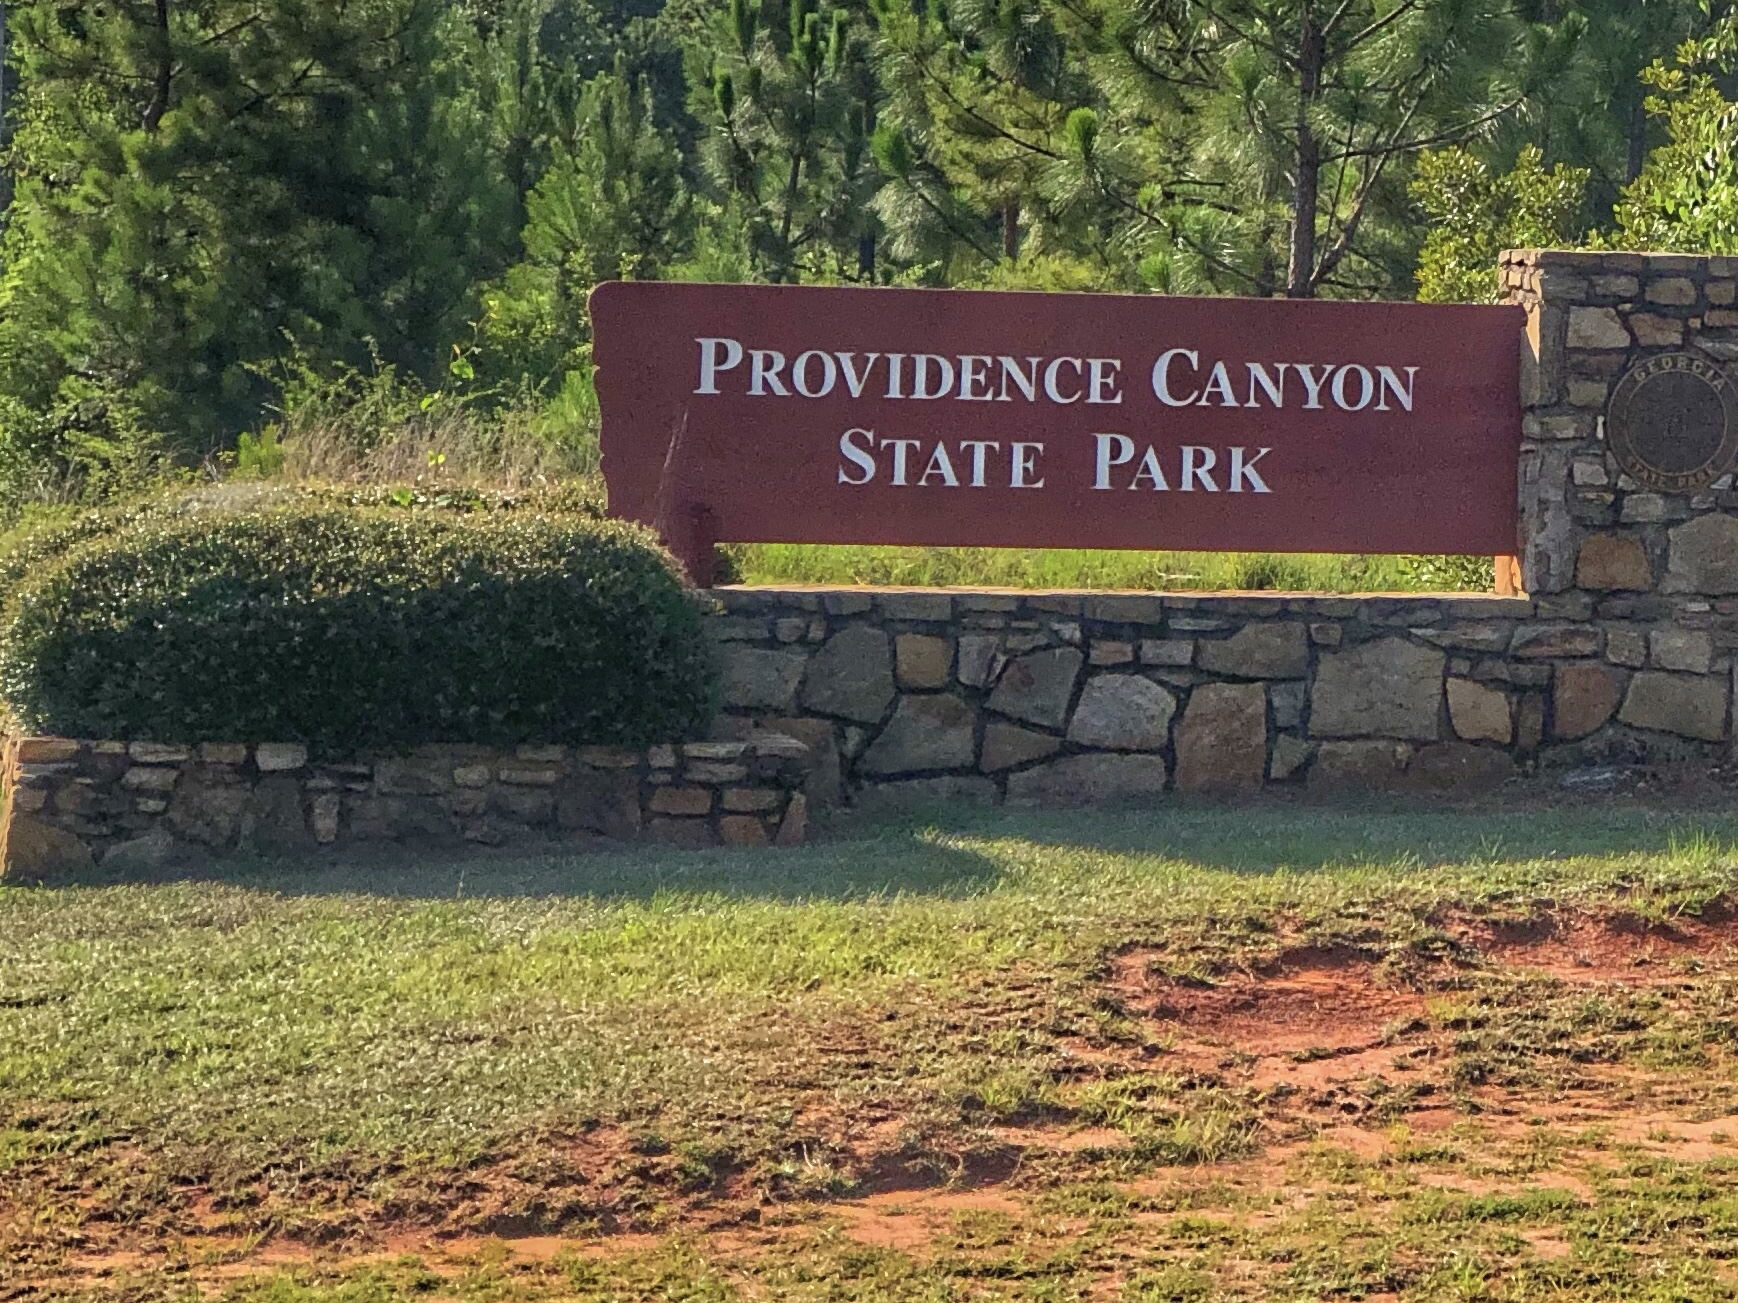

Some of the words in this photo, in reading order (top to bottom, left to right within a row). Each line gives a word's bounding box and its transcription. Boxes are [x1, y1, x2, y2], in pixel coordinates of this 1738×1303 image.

[692, 337, 1123, 404] PROVIDENCE
[1152, 348, 1420, 411] CANYON
[1634, 356, 1725, 391] GEORGIA
[837, 427, 1046, 489] STATE
[1093, 432, 1273, 493] PARK
